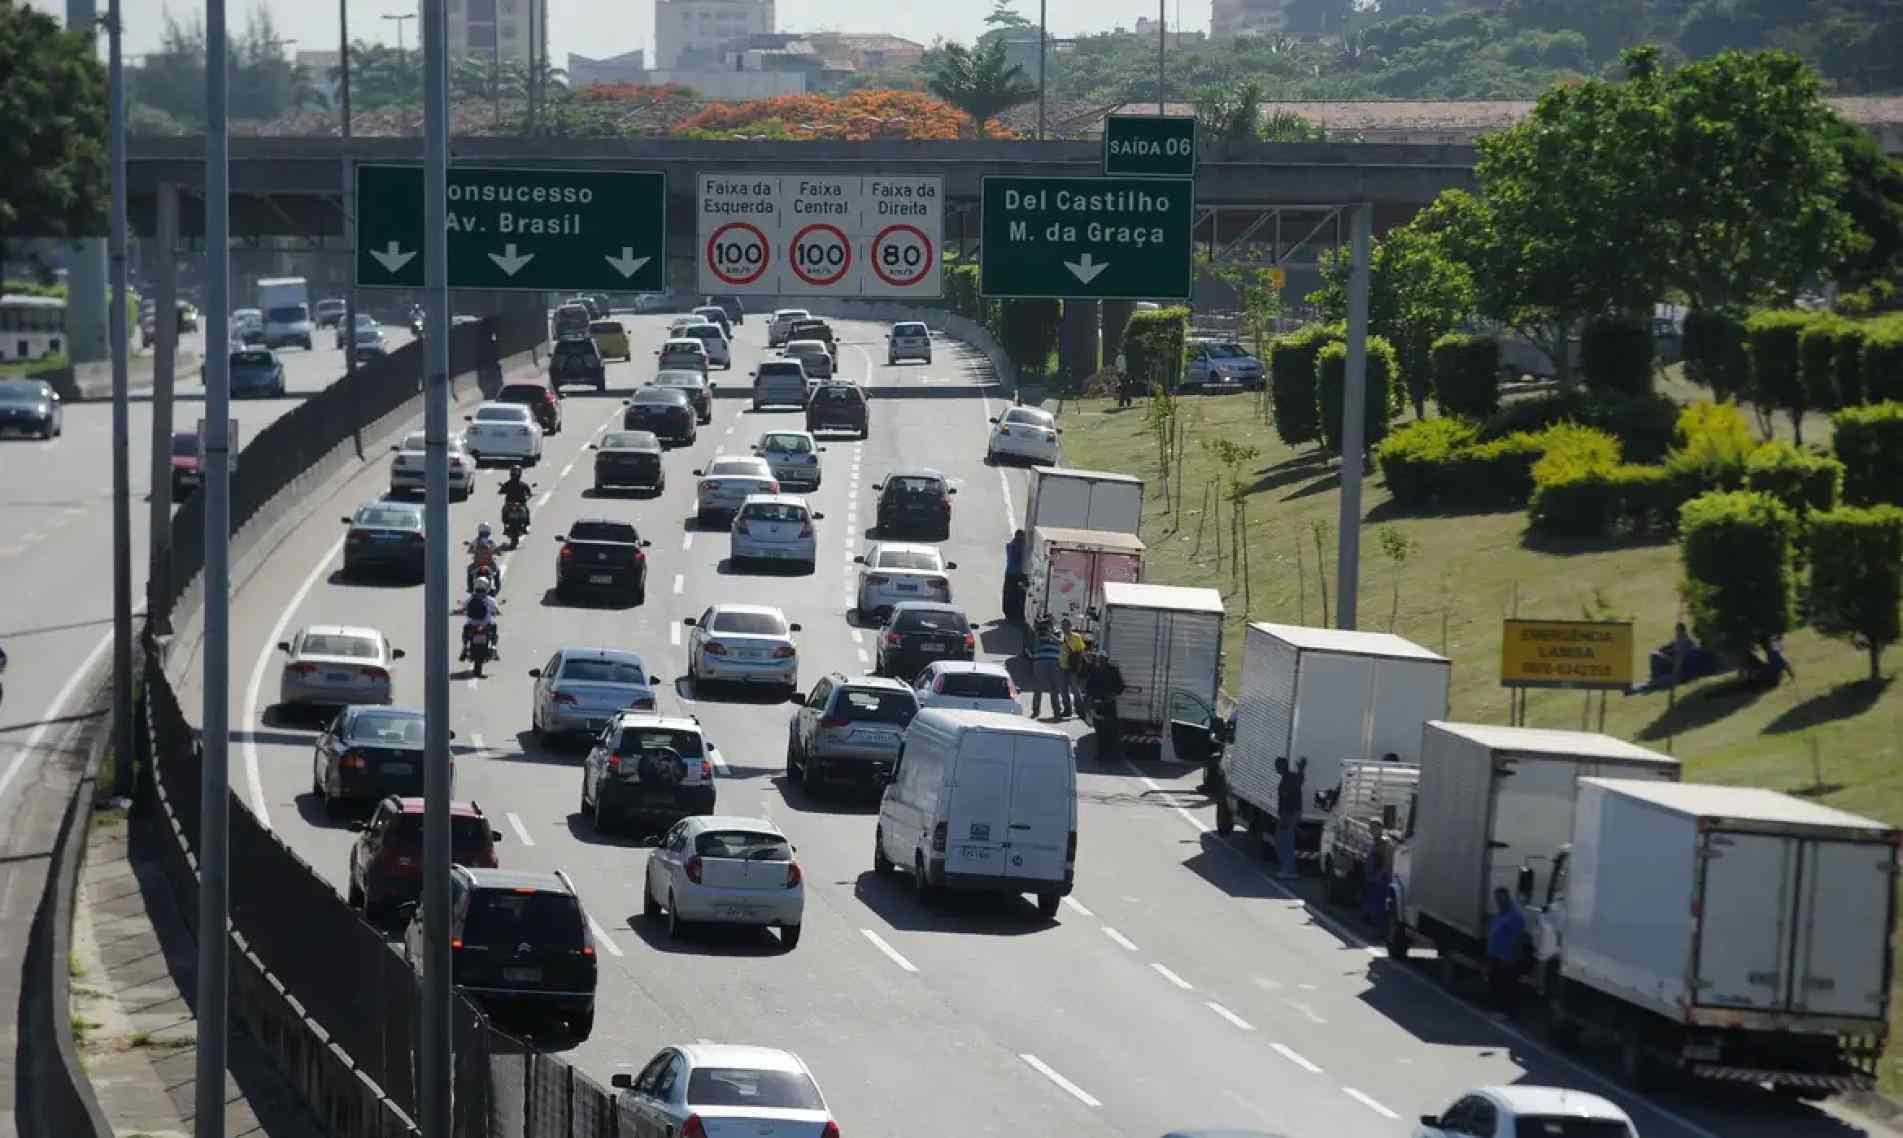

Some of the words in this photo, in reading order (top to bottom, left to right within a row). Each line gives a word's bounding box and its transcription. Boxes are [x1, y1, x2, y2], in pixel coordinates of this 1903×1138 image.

[1110, 138, 1161, 155] SAÍDA
[1166, 138, 1192, 156] 06
[447, 184, 593, 203] onsucesso
[706, 180, 748, 196] Faixa
[753, 180, 772, 196] da
[800, 181, 842, 197] Faixa
[872, 182, 913, 198] Faixa
[916, 183, 936, 198] da
[704, 198, 774, 216] Esquerda
[794, 199, 849, 214] Central
[878, 199, 928, 216] Direita
[1005, 189, 1047, 210] Del
[1056, 190, 1169, 212] Castilho
[446, 212, 486, 232] Av.
[499, 212, 581, 235] Brasil
[1009, 221, 1035, 241] M.
[1046, 222, 1077, 242] da
[1087, 222, 1165, 248] Graça
[715, 242, 763, 265] 100
[797, 243, 844, 266] 100
[883, 244, 921, 266] 80
